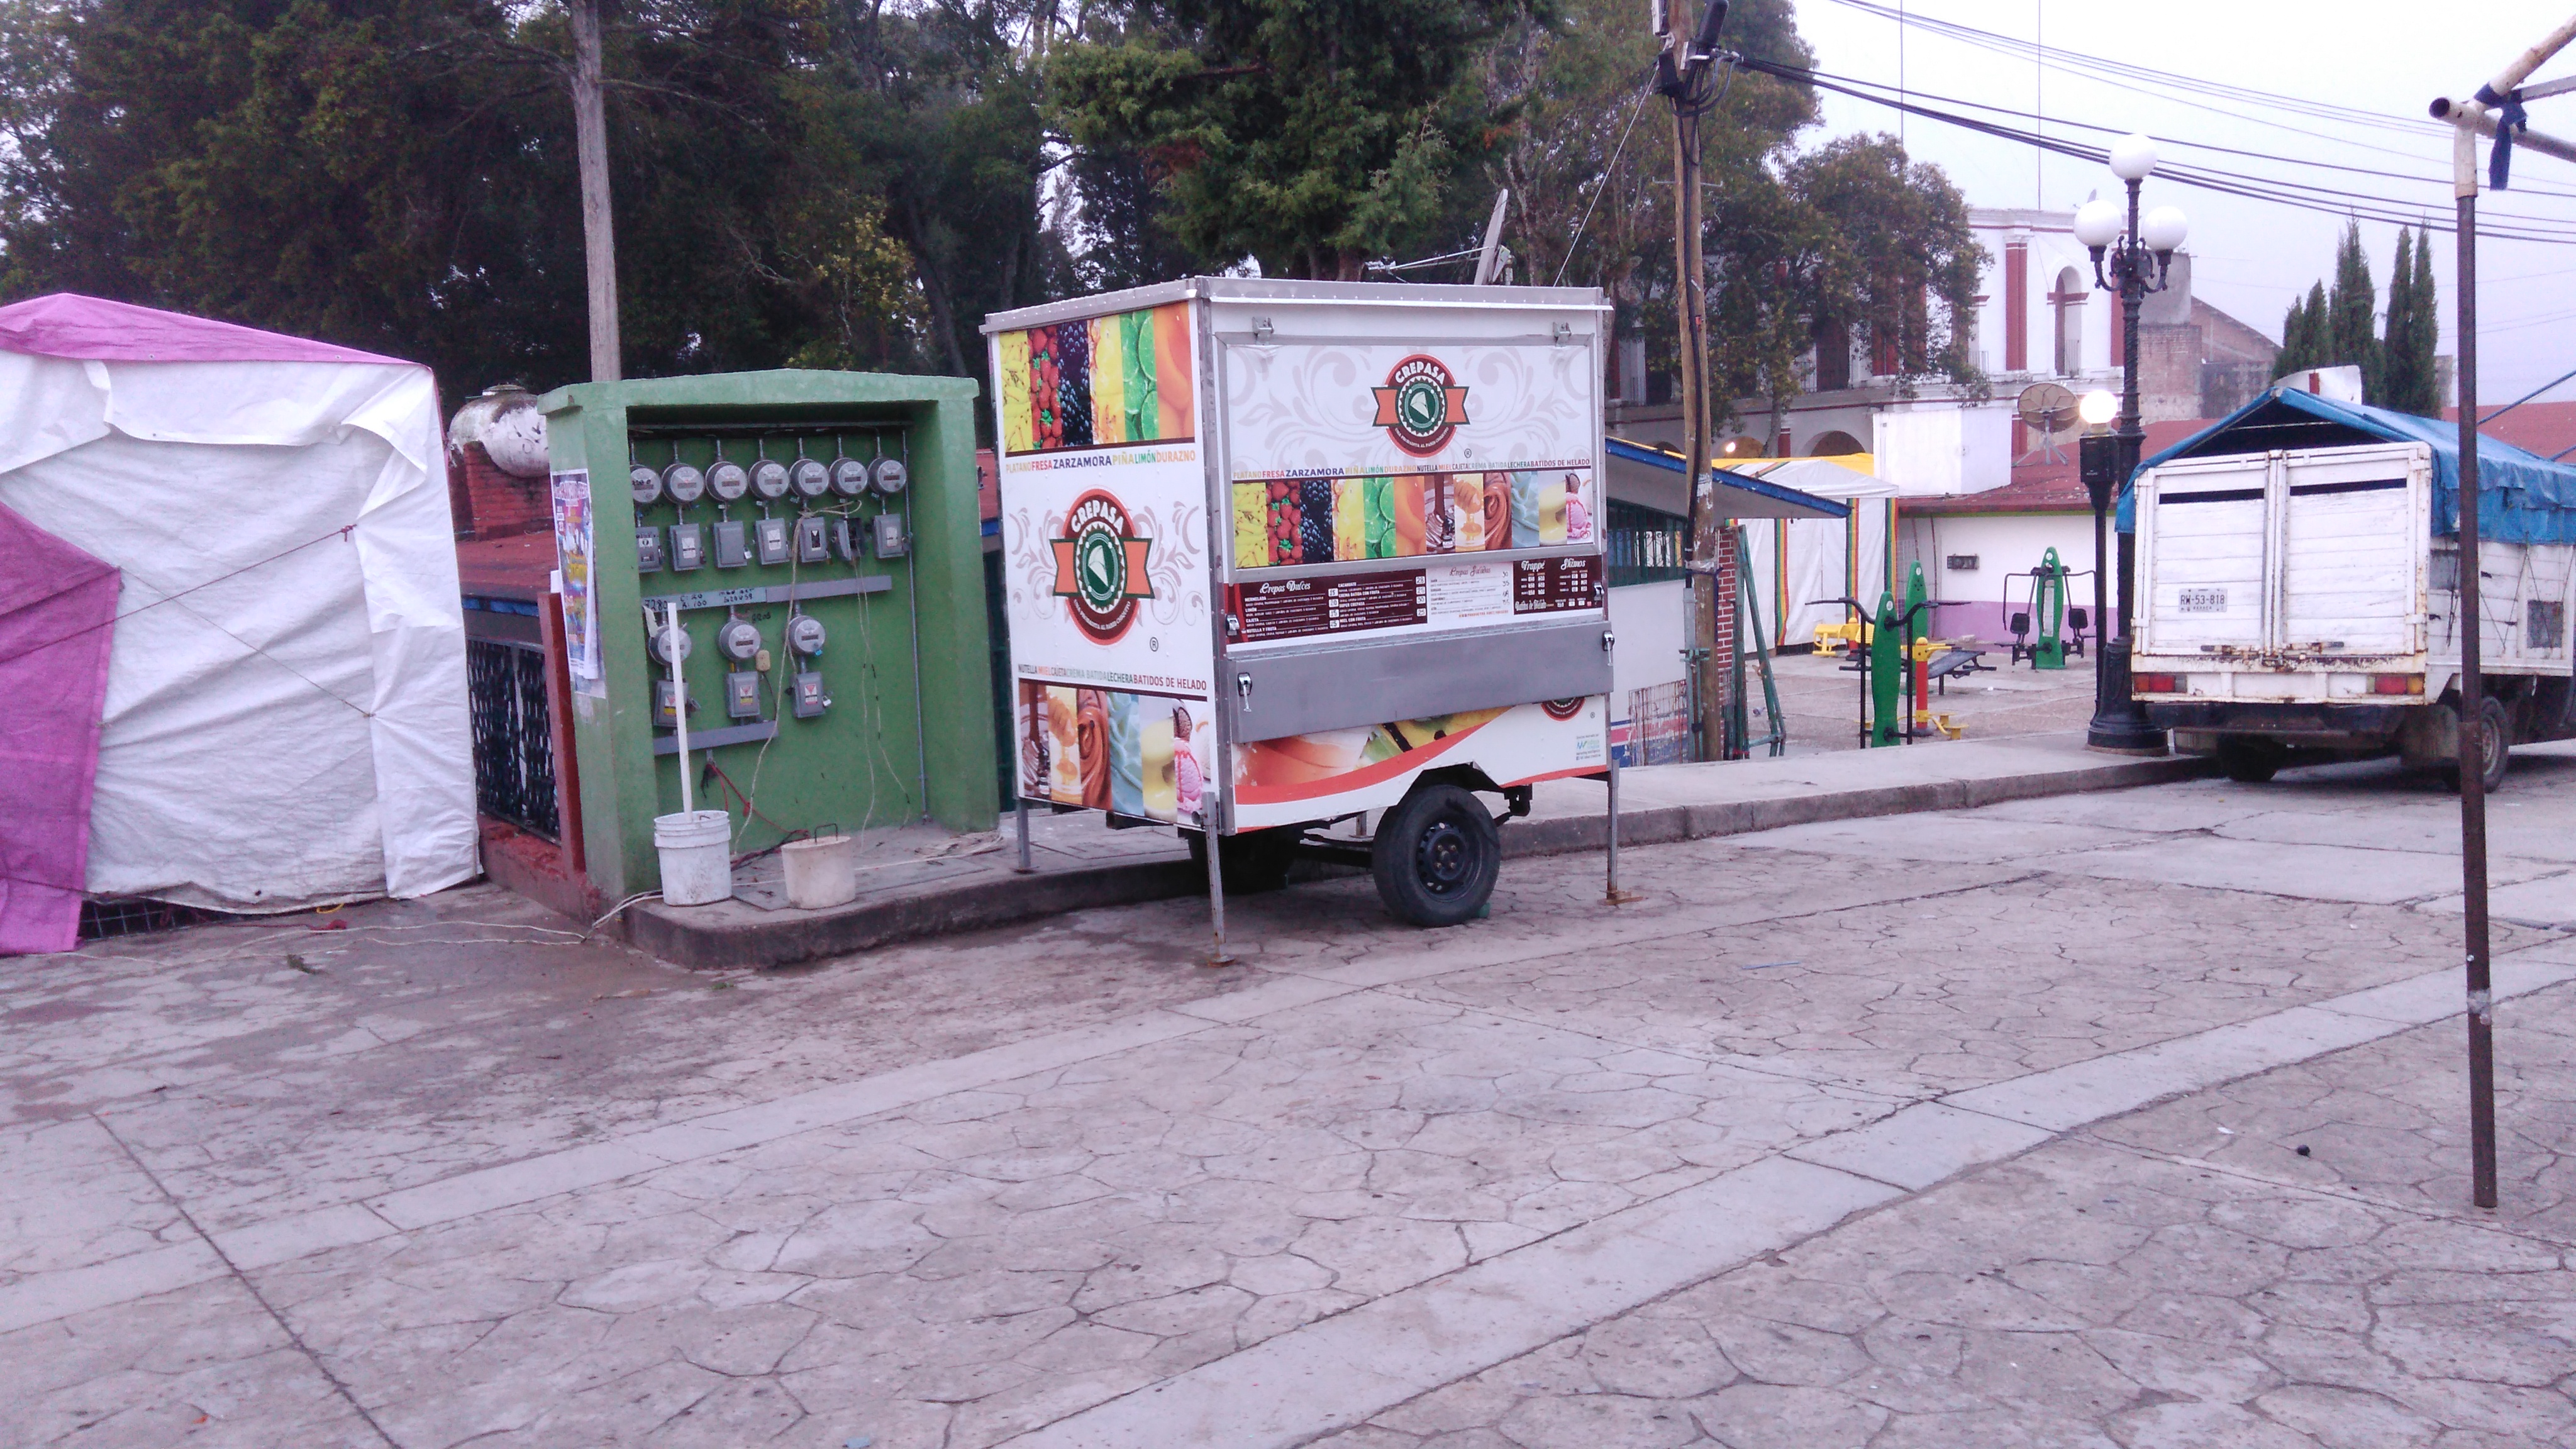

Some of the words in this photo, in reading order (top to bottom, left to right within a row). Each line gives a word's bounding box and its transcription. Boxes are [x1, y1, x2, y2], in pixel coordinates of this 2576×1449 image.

[1395, 361, 1445, 385] CREPASA
[1006, 462, 1031, 473] PLATANO
[1031, 459, 1053, 471] FRESA
[1053, 455, 1112, 469] ZARZAMORA
[1113, 451, 1134, 465] PIÑA
[1135, 450, 1156, 464] LIMÓN
[1156, 450, 1195, 464] DURAZNO
[1233, 471, 1262, 479] PLATANO
[1285, 467, 1345, 477] ZARZAMORA
[1345, 465, 1365, 475] PIÑA
[1365, 464, 1384, 474] LIMÓN
[1384, 465, 1416, 473] DURAZNO
[1507, 460, 1531, 469] LECHERA
[1071, 500, 1124, 535] CREPASA
[1260, 582, 1285, 595] Crepas
[1286, 580, 1311, 592] Dulces
[1018, 664, 1038, 674] NUTELLA
[1107, 671, 1133, 684] LECHERA
[1133, 674, 1164, 687] BATIDOS
[1165, 677, 1175, 687] DE
[1177, 677, 1207, 691] HELADO
